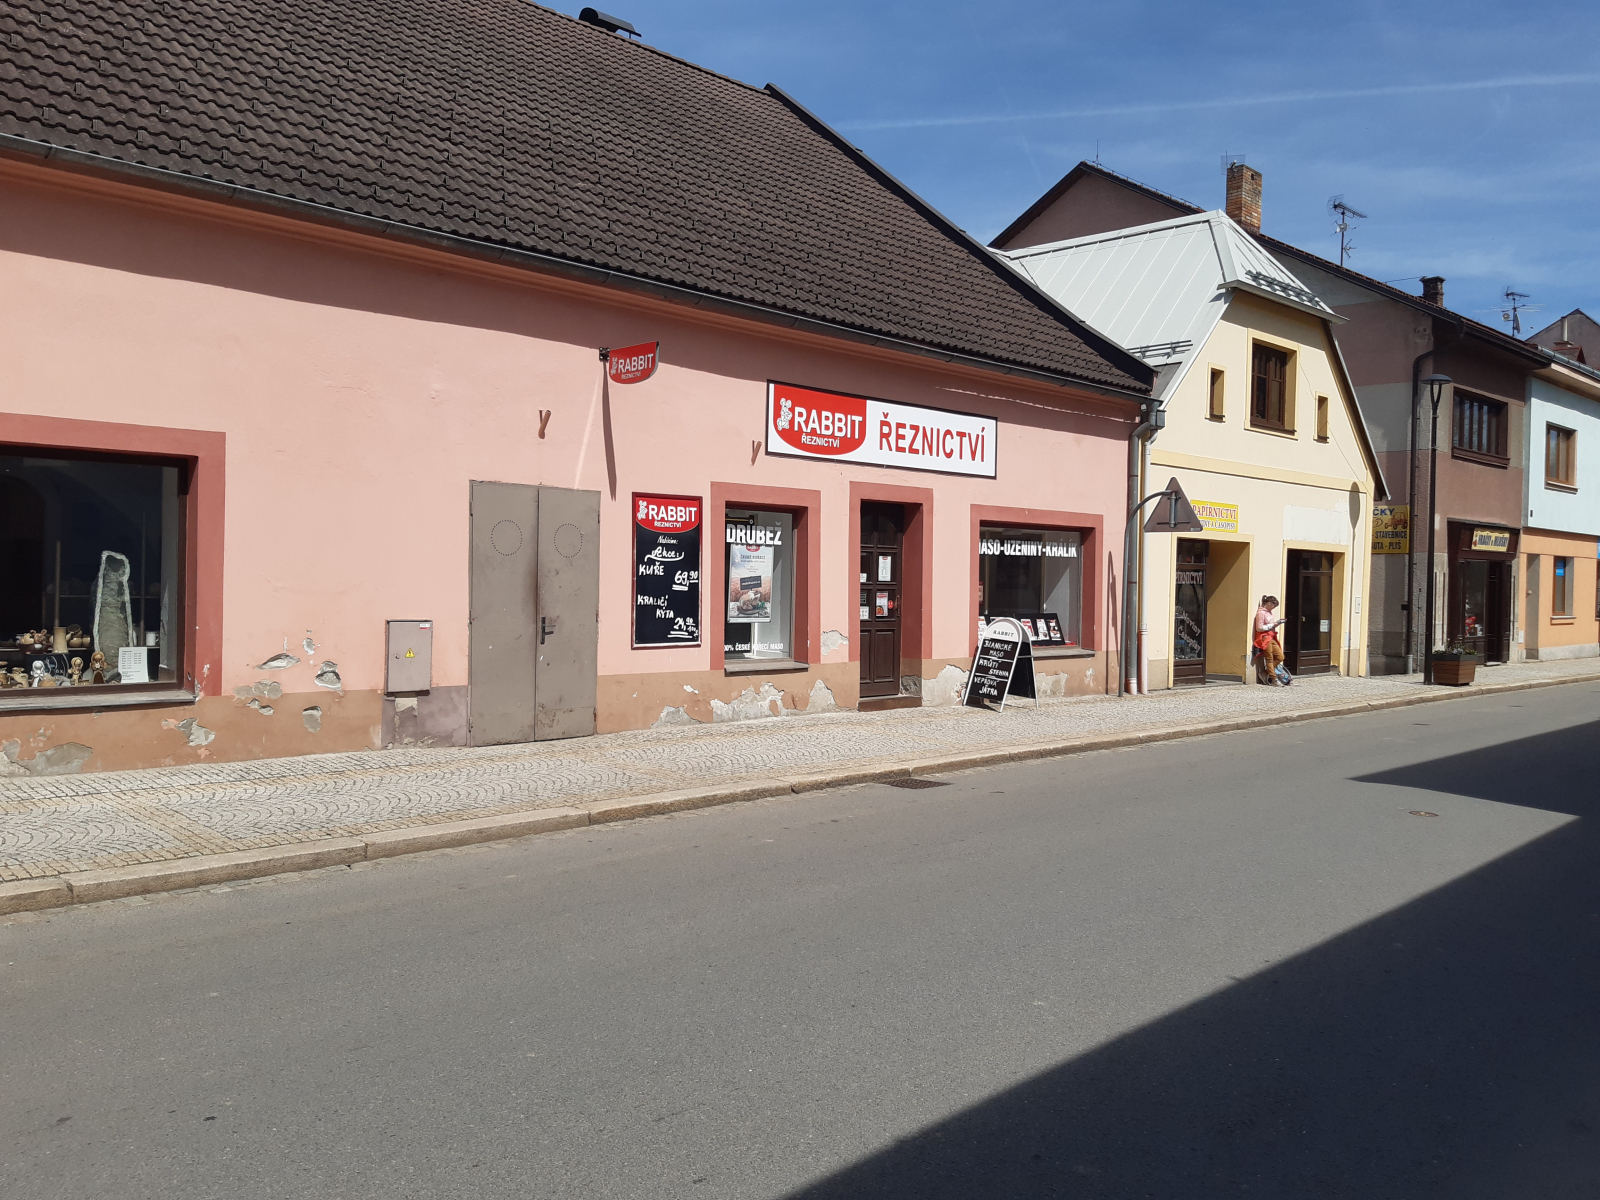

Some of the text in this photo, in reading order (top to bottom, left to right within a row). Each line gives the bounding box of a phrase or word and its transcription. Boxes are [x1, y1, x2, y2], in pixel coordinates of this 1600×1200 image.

[618, 354, 654, 373] RABBIT
[794, 406, 863, 440] RABBIT
[801, 432, 840, 448] ŘEZNICTVÍ
[879, 411, 986, 463] ŘEZNICTVÍ
[648, 504, 697, 522] RABBIT
[1373, 507, 1396, 516] ČKY
[654, 520, 682, 528] ŘEZNICTVÍ
[726, 519, 782, 545] DRŮBEŽ
[639, 562, 665, 576] KUŘE
[656, 607, 674, 619] KÝTA
[735, 642, 751, 651] ČESKÉ
[770, 642, 784, 650] MASO
[989, 650, 1005, 658] MASO
